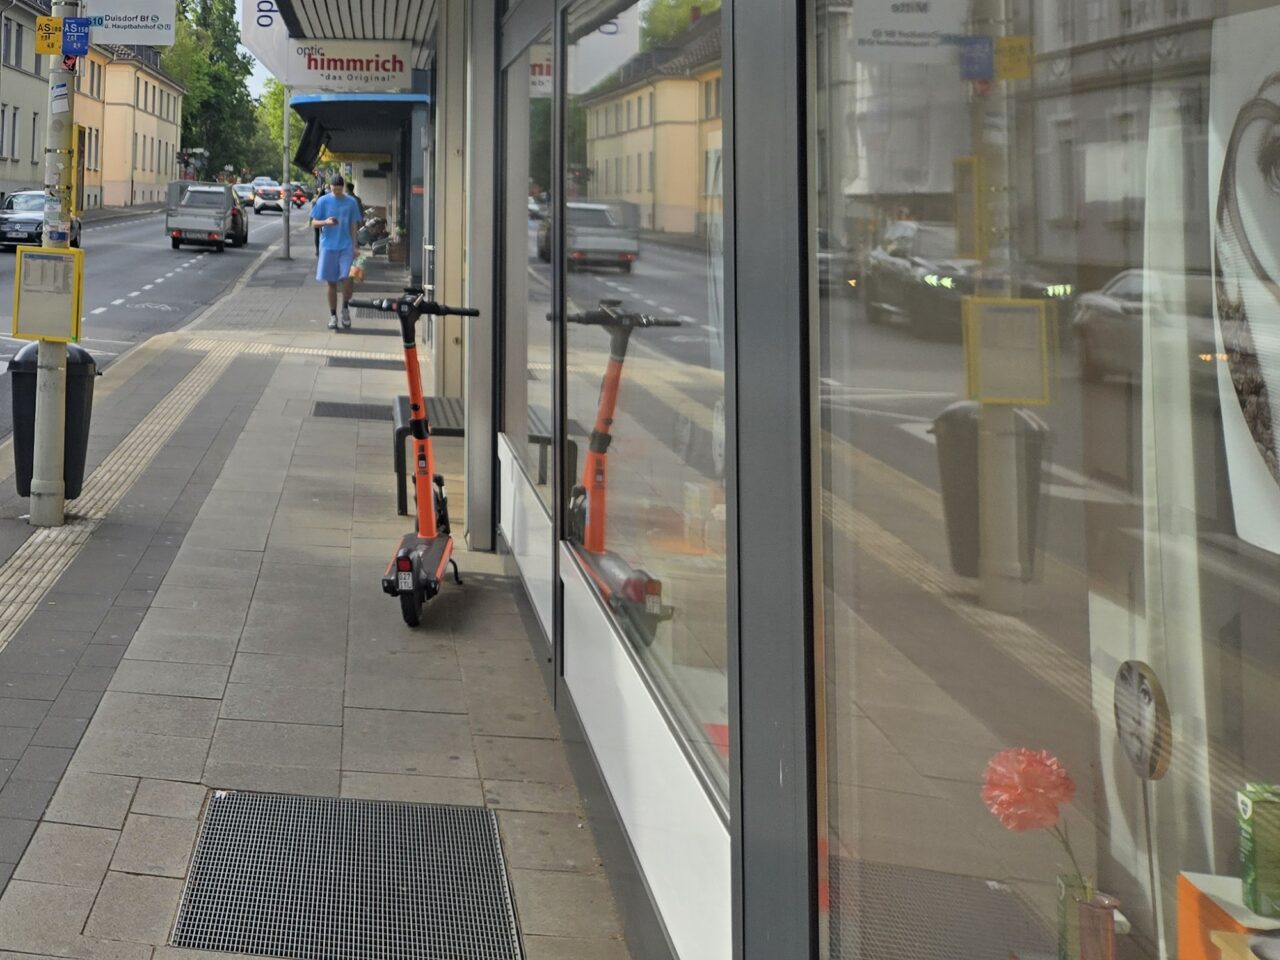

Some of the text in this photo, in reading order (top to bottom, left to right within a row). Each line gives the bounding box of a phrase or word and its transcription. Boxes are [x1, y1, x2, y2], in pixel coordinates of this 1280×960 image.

[104, 14, 138, 22] Duisdorf
[296, 44, 324, 57] optic
[307, 52, 403, 72] himmrich
